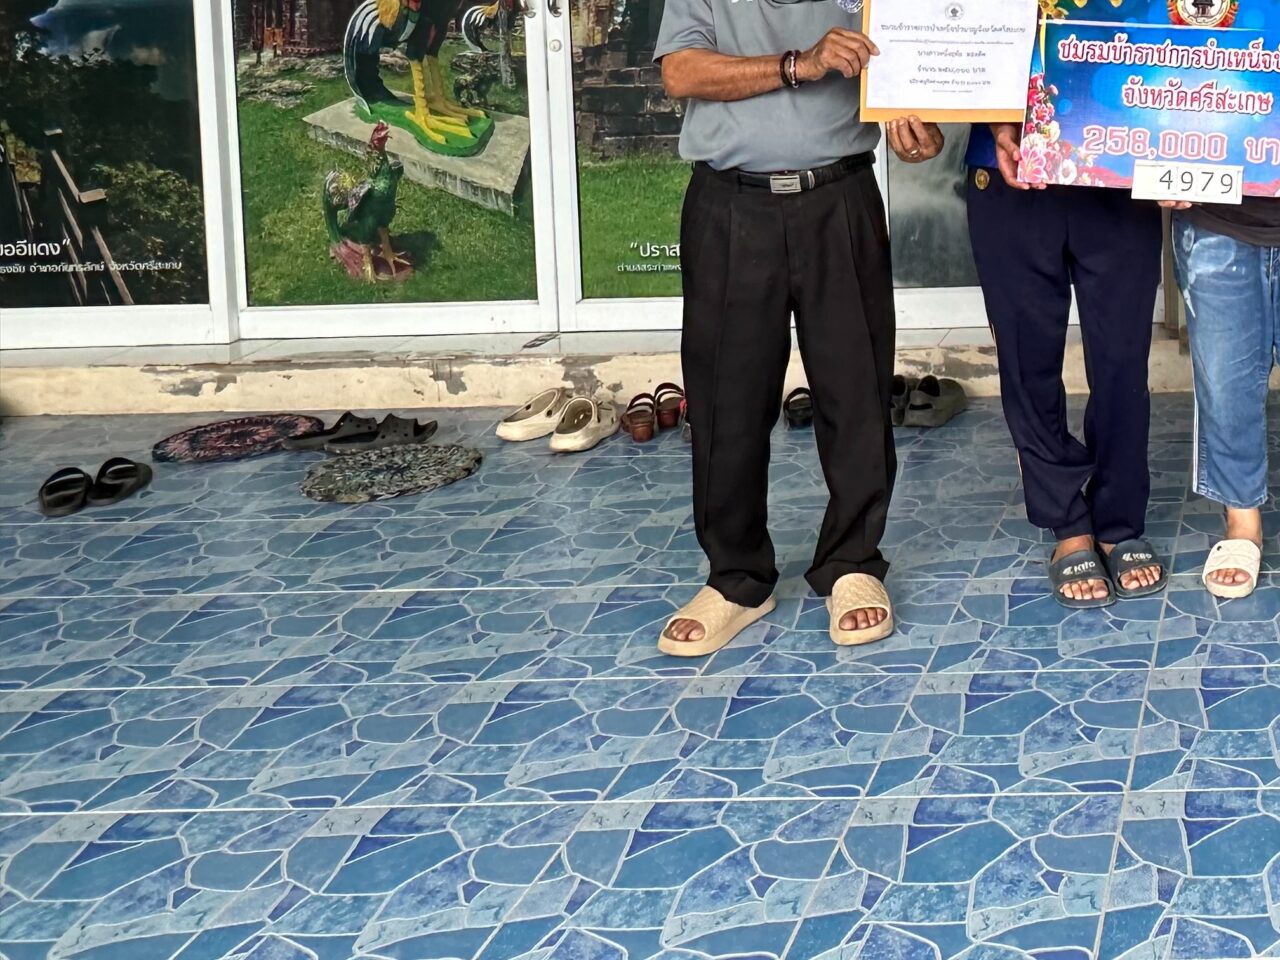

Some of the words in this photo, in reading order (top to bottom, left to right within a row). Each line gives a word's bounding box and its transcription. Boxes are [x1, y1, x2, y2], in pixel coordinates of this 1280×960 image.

[1123, 77, 1273, 114] จังหวัดศรีสะเกษ
[1083, 126, 1228, 160] 258,000
[1159, 169, 1234, 194] 4979
